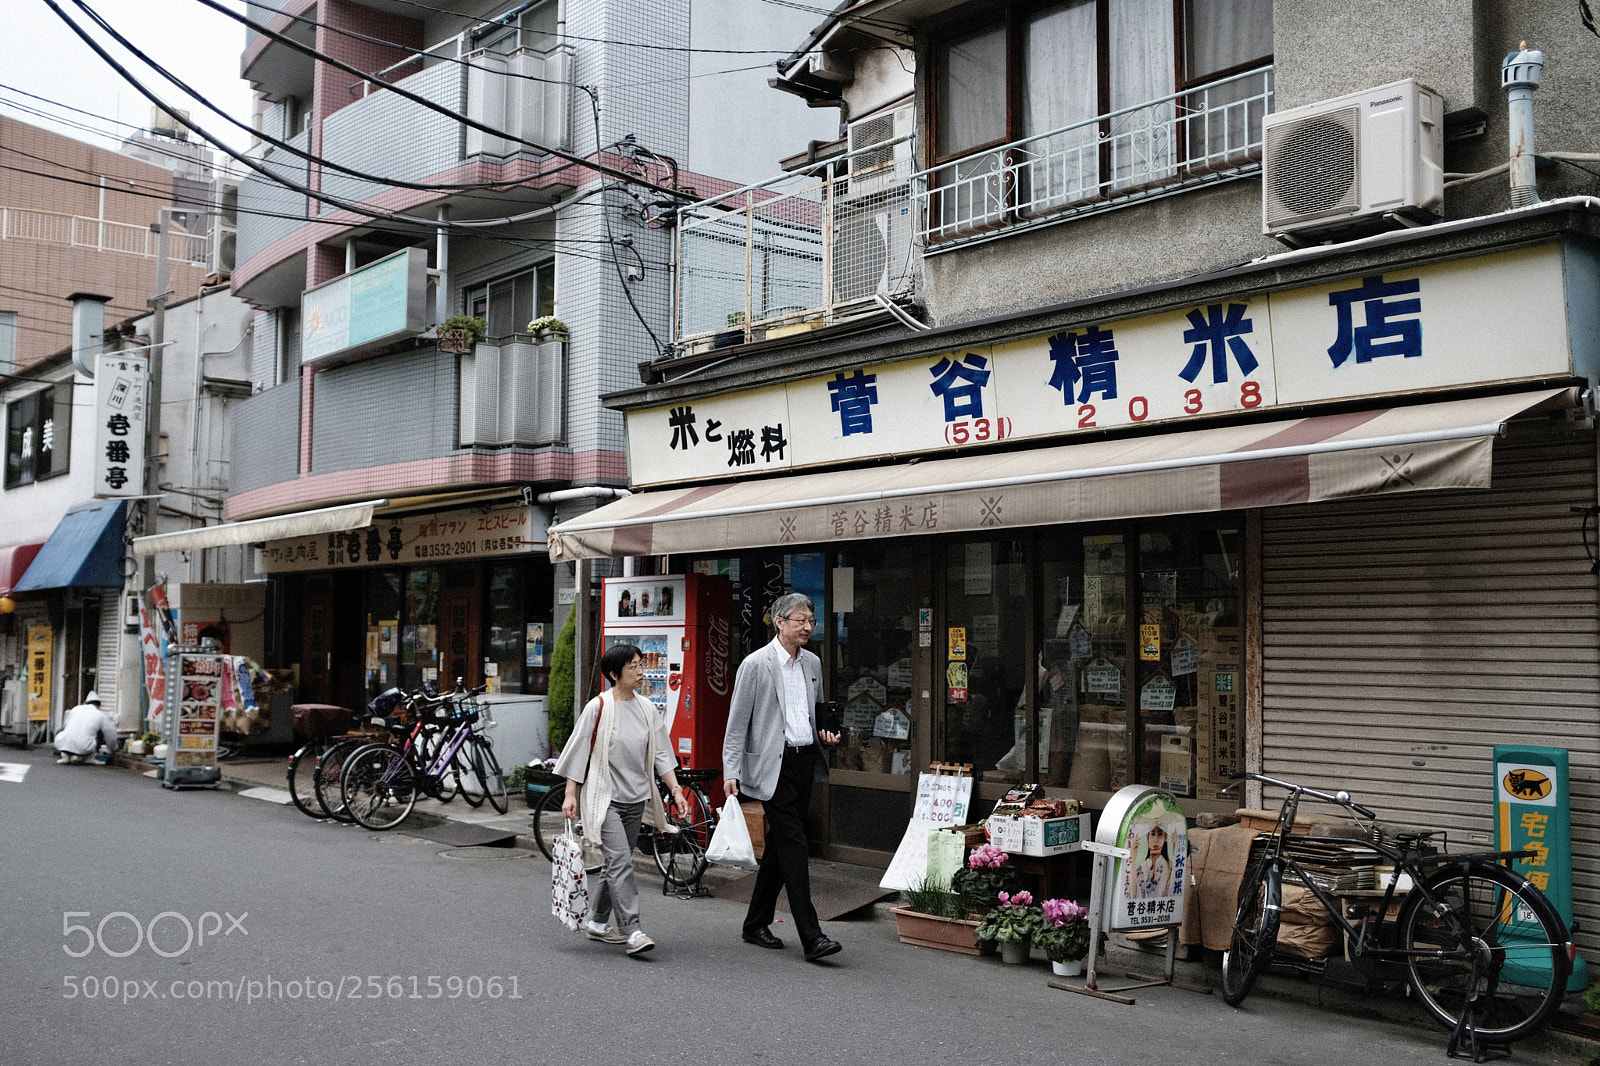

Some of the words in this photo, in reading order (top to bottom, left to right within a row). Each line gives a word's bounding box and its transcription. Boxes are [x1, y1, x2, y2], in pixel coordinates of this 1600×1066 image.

[1369, 94, 1404, 109] Panasonic
[827, 274, 1423, 438] 菅谷精米店
[105, 413, 131, 489] 壱番亭
[668, 405, 788, 468] 米と燃料
[831, 500, 939, 537] 菅谷精米店
[34, 651, 45, 698] 一番搾り
[1218, 694, 1228, 777] 菅谷精米店
[1173, 854, 1185, 894] 秋田米
[1127, 898, 1175, 916] 菅谷精米店
[1130, 917, 1140, 925] TEL
